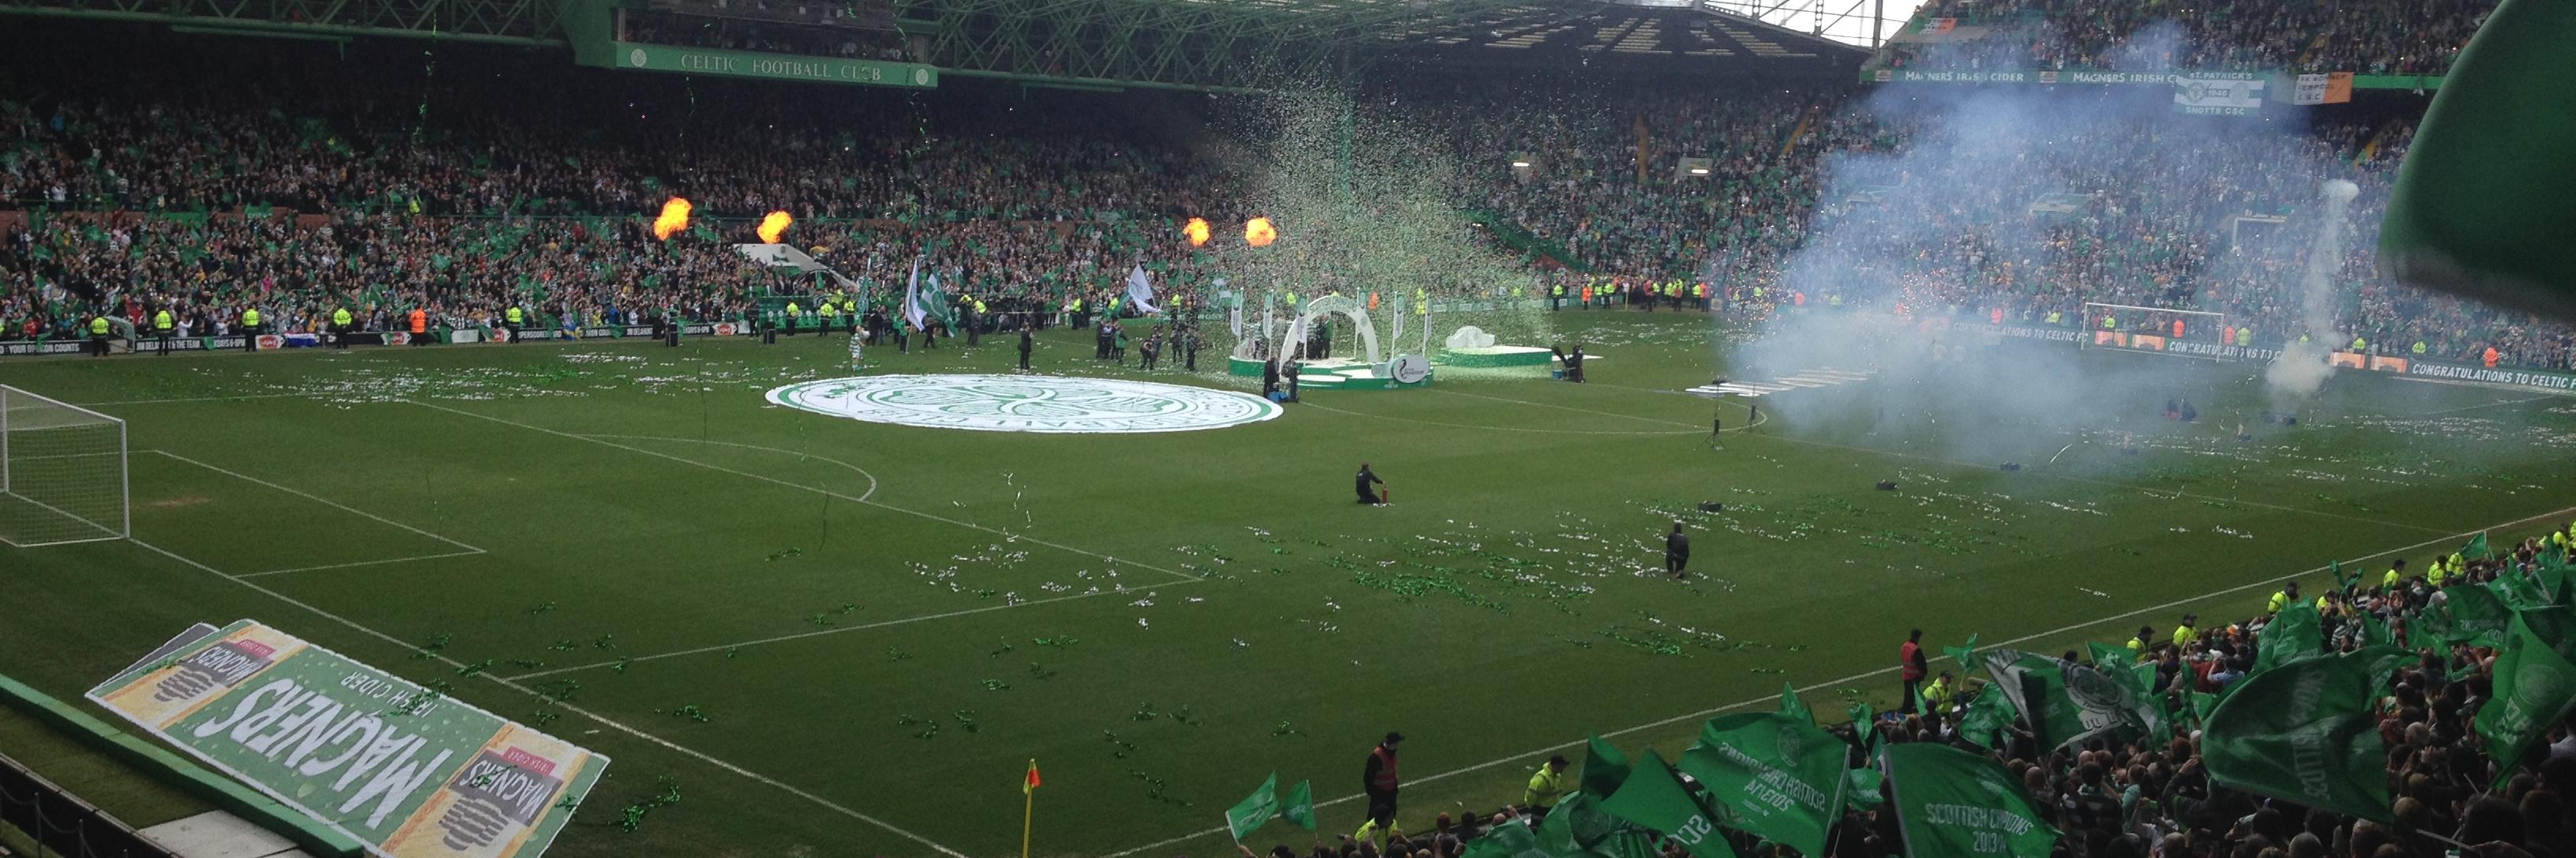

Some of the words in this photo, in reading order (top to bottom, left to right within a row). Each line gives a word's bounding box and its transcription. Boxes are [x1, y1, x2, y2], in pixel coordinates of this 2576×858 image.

[681, 54, 739, 71] CELTIC
[753, 59, 832, 77] FOOTBALL
[1990, 73, 2024, 81] CIDER
[2073, 72, 2125, 83] MAGNERS
[54, 343, 79, 352] COUNTS
[2034, 329, 2045, 338] TO
[2046, 329, 2075, 341] CELTIC
[2413, 363, 2512, 384] CONGRATULATIONS
[2516, 372, 2529, 385] TO
[2530, 374, 2569, 389] CELTIC
[186, 646, 258, 683] MAGNERS
[340, 672, 393, 698] CIDER
[193, 678, 454, 830] MAGNERS
[459, 759, 553, 818] MAGNERS
[1924, 803, 1987, 828] SCOTTISH
